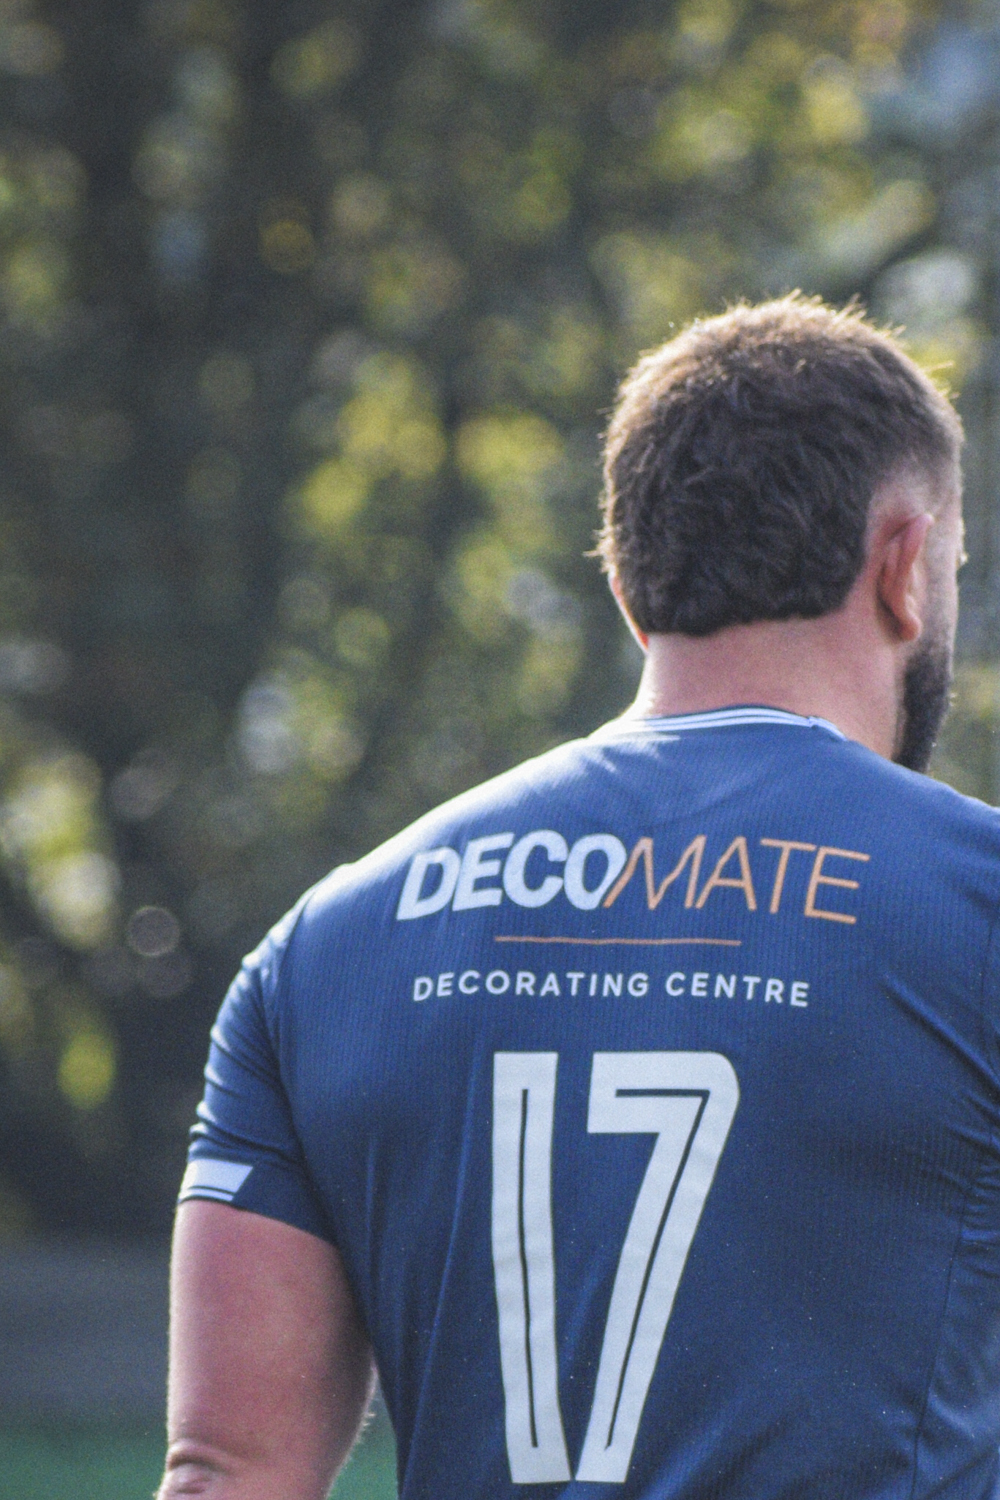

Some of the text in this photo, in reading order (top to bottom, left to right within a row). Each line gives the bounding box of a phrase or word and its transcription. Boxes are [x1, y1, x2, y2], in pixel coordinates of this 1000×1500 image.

[396, 829, 871, 924] DECOMATE
[413, 969, 810, 1007] DECORATING CENTRE
[491, 1051, 740, 1484] 17
